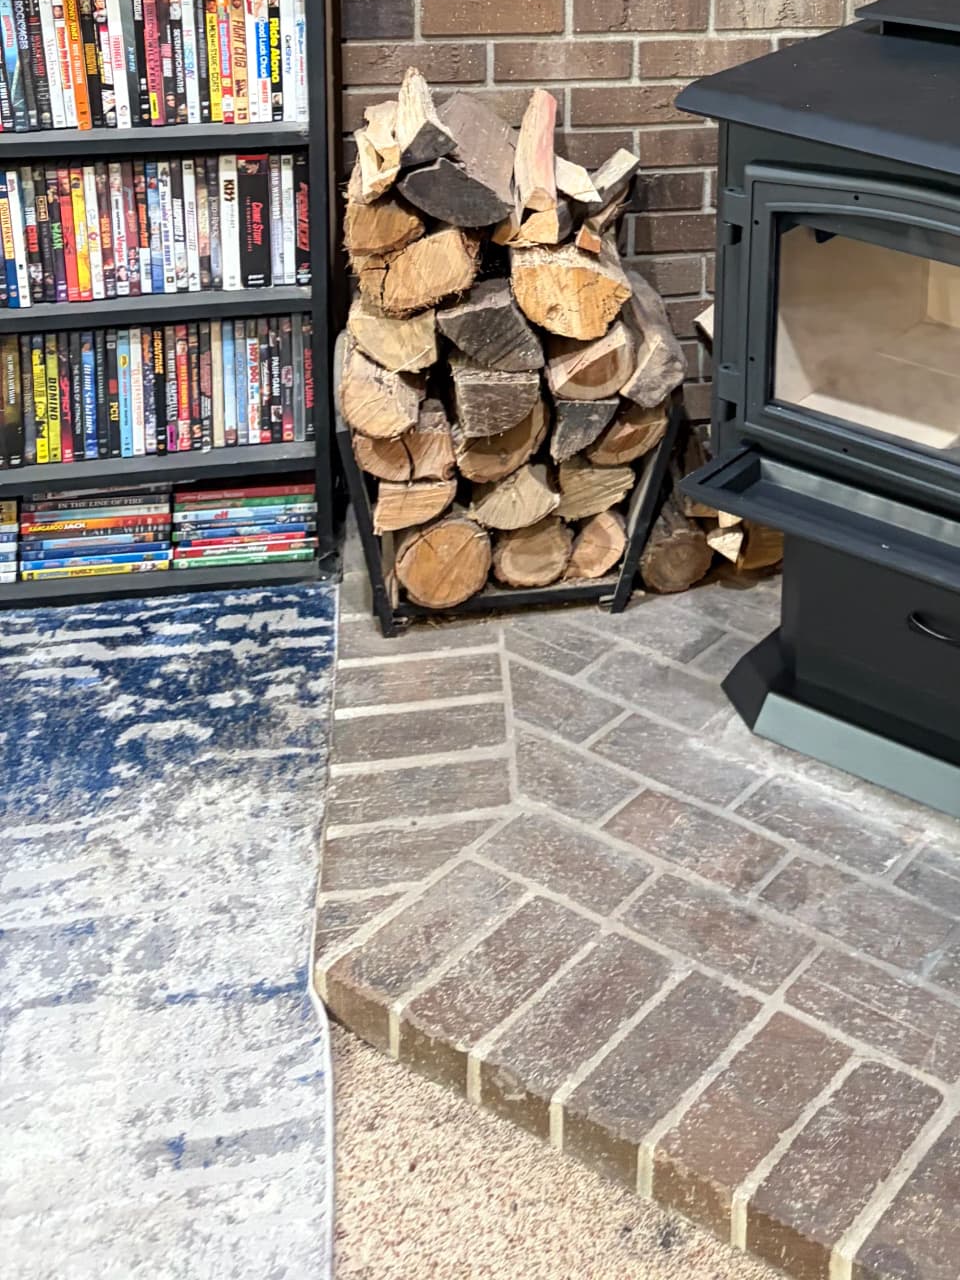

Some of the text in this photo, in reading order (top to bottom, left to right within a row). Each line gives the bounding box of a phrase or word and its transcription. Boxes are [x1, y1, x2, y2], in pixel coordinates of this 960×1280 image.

[15, 0, 29, 50] ROCK AGES
[70, 22, 78, 40] TUNES
[173, 28, 181, 49] SEVEN
[233, 20, 247, 68] FIGHT CLUB
[257, 17, 268, 77] Good Luck Chuck
[269, 17, 280, 83] Ride Along
[147, 45, 155, 67] WILL
[210, 48, 218, 67] STARE
[211, 72, 219, 92] GOATS
[224, 179, 235, 202] KISS
[252, 202, 264, 245] CRIME STORY
[28, 225, 38, 252] COLD
[52, 223, 63, 249] MASK
[115, 234, 125, 263] Vegas
[154, 331, 163, 374] SHOWTIME
[271, 356, 280, 375] PAIN
[48, 377, 58, 421] DOMINO
[74, 393, 80, 401] OF
[305, 378, 314, 408] YUMA
[110, 402, 119, 421] PCU
[124, 497, 143, 505] FIRE
[214, 510, 229, 519] elf
